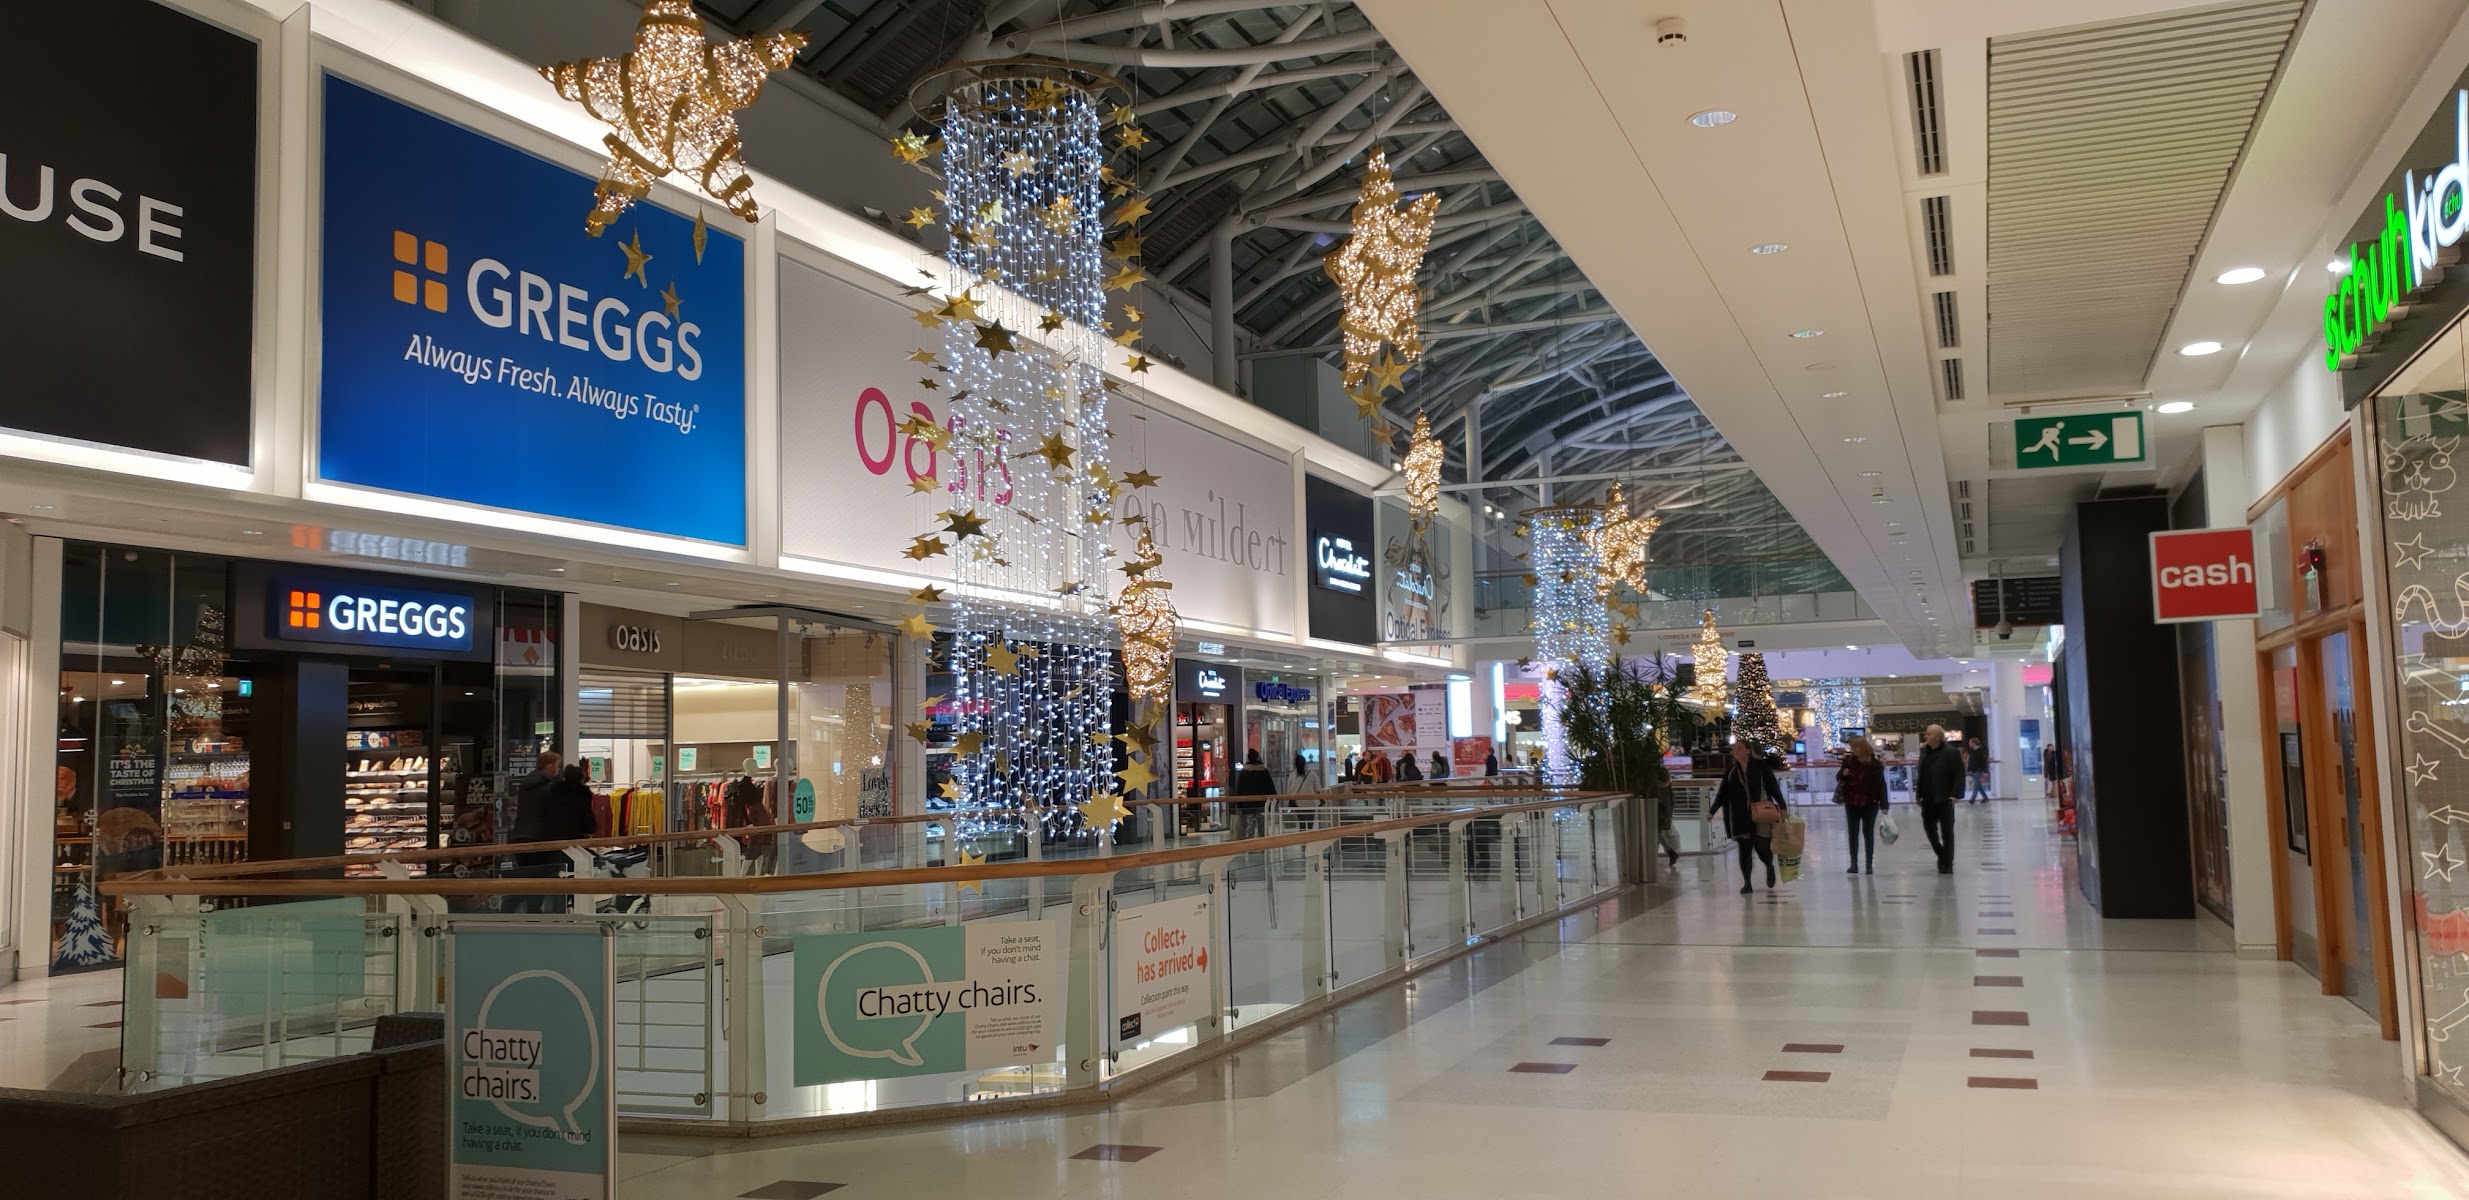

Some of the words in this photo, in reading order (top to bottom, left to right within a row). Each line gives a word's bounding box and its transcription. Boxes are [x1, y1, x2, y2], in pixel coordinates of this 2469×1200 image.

[467, 258, 703, 381] GREGGS
[404, 334, 492, 384] Always
[498, 357, 562, 397] Fresh.
[567, 376, 638, 419] Always
[2160, 555, 2253, 588] cash
[329, 595, 466, 639] GREGGS
[110, 769, 140, 778] TASTE
[142, 769, 155, 777] OF
[134, 759, 155, 769] THE
[110, 778, 155, 786] CHRISTMAS
[980, 947, 986, 955] if
[987, 948, 1001, 957] you
[1002, 945, 1021, 953] don't
[1022, 944, 1041, 952] mind
[1000, 936, 1016, 945] Take
[1144, 926, 1187, 954] Collect+
[992, 955, 1016, 965] having
[1023, 954, 1041, 962] chat.
[1137, 959, 1156, 985] has
[1158, 947, 1194, 979] arrived
[859, 987, 951, 1019] Chatty
[958, 978, 1042, 1009] chairs.
[464, 1030, 541, 1069] Chatty
[464, 1067, 537, 1100] chairs.
[463, 1122, 484, 1135] Take
[485, 1126, 490, 1135] a
[523, 1128, 541, 1140] you
[542, 1128, 565, 1140] don't
[567, 1129, 591, 1142] mind
[463, 1136, 493, 1152] having
[494, 1141, 500, 1150] a
